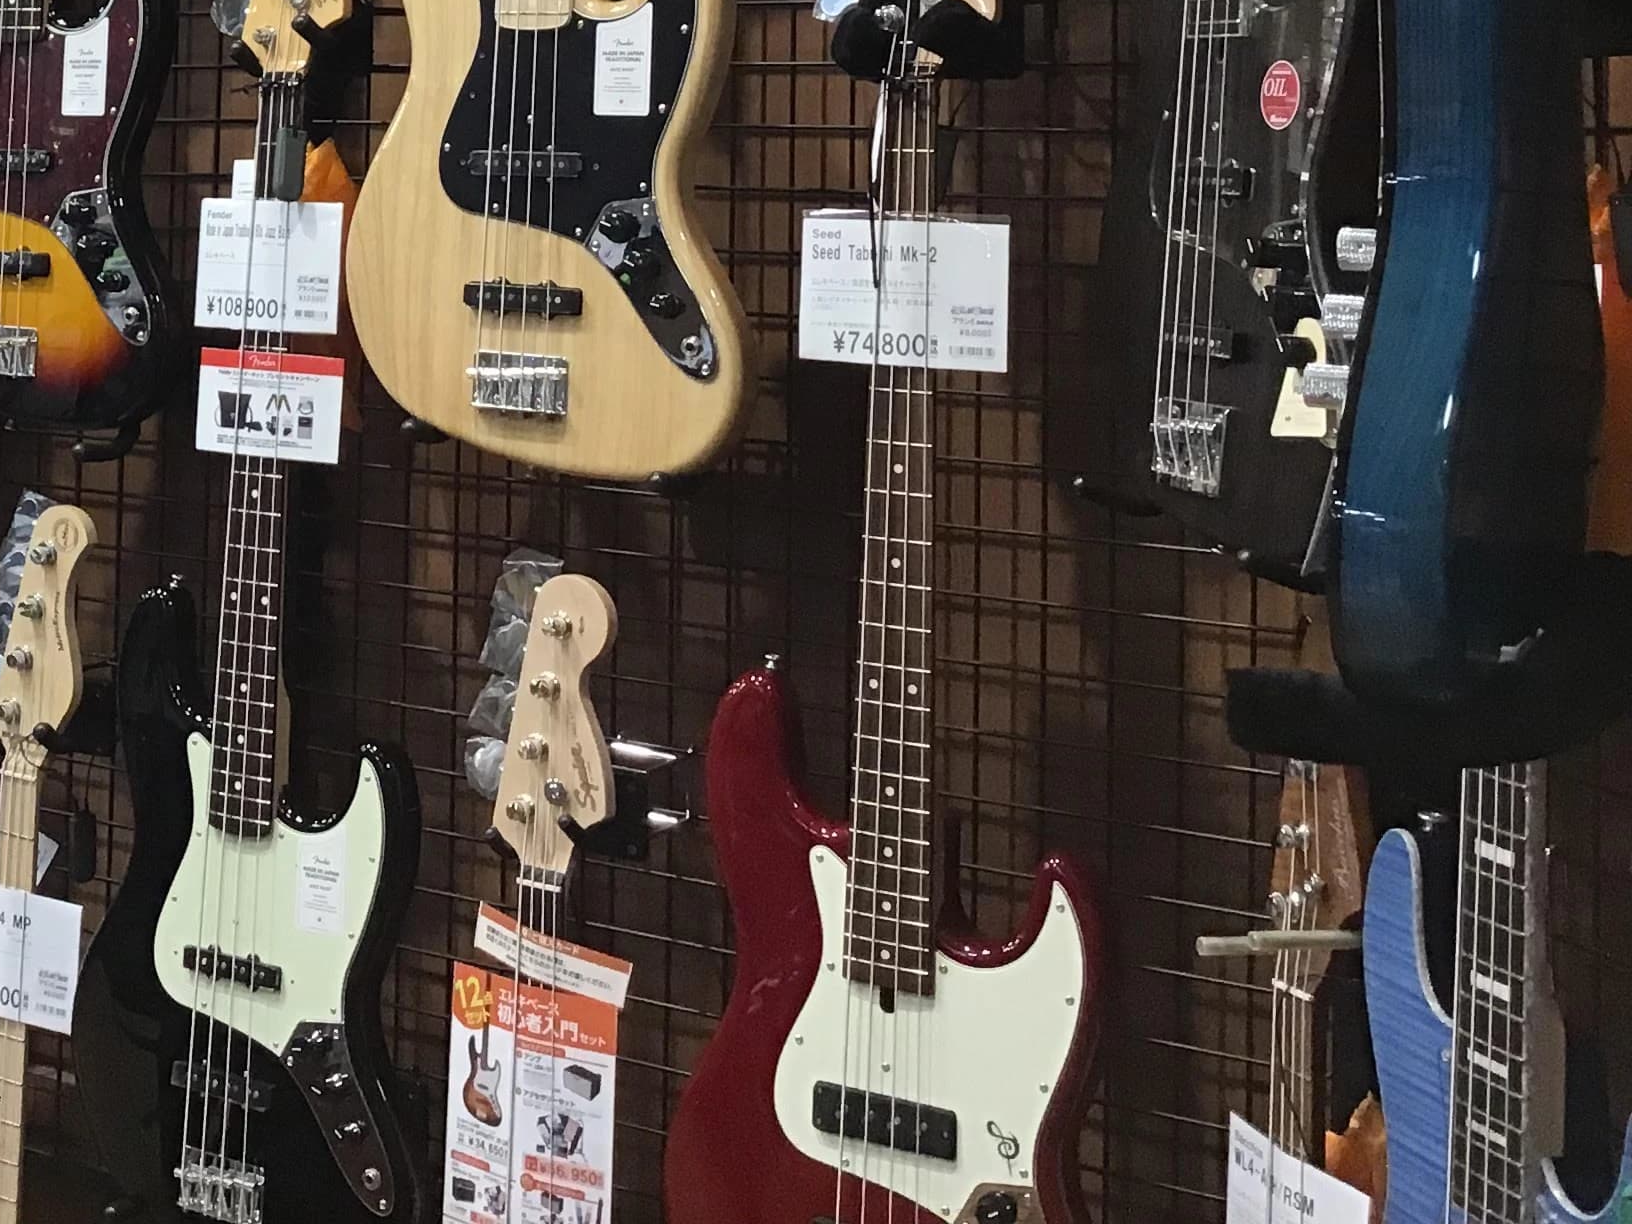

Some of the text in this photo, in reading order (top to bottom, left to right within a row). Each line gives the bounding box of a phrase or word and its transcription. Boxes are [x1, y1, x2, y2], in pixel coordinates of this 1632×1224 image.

[1263, 78, 1288, 96] OIL
[812, 228, 841, 239] Seed
[812, 244, 937, 263] Seed Tabhi Mk-2
[207, 295, 279, 319] ¥108900
[833, 329, 927, 357] ¥74800
